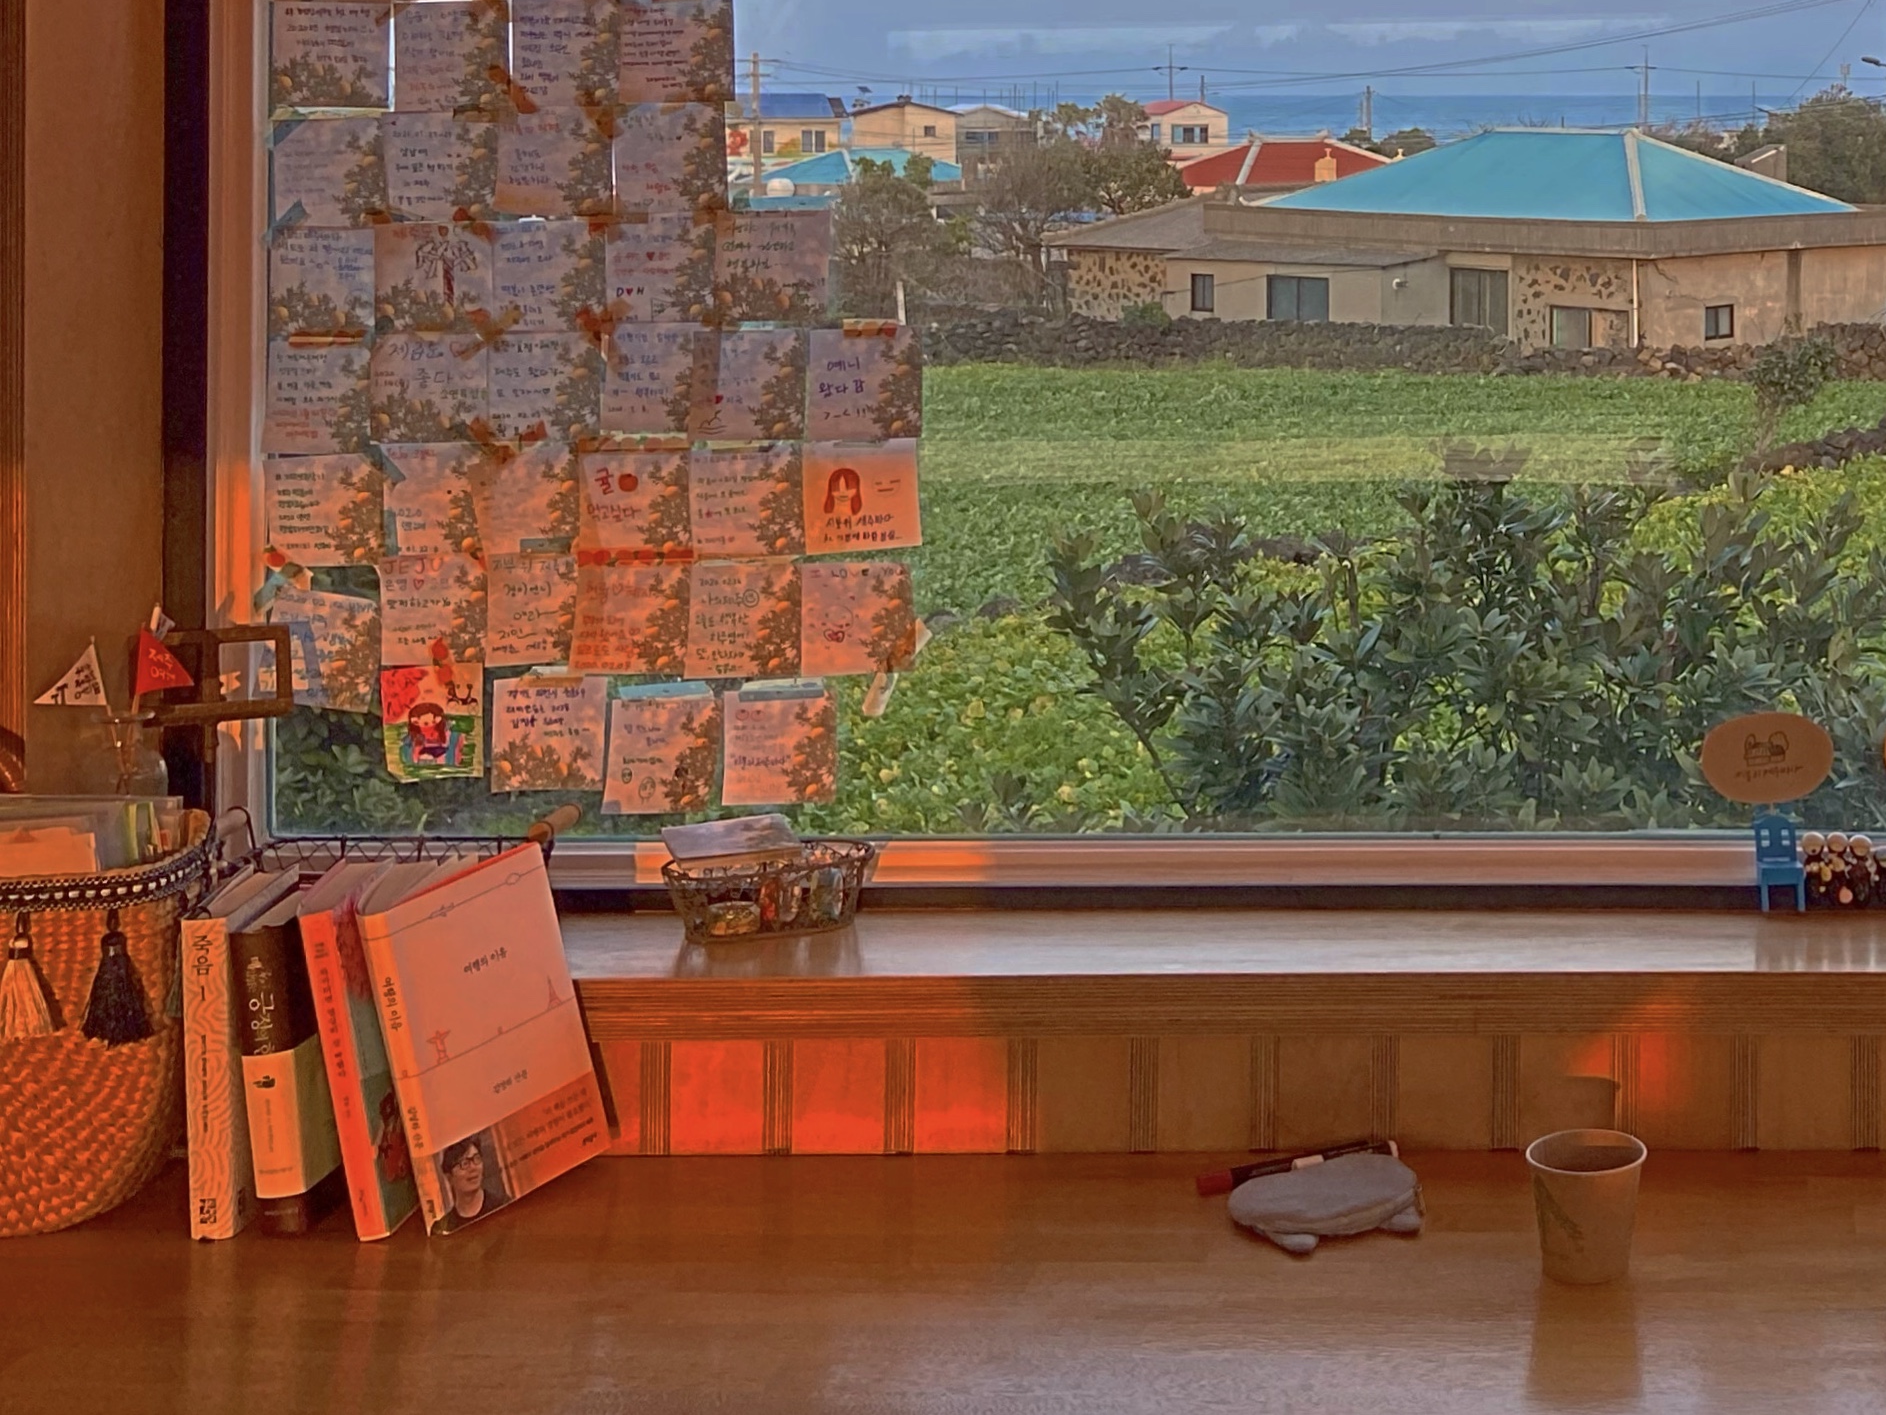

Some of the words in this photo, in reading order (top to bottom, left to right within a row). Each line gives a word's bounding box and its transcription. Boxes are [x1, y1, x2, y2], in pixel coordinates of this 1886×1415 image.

[594, 466, 614, 495] 귤
[383, 557, 443, 575] JEJU
[831, 567, 870, 579] LOVE
[192, 935, 213, 976] 죽음
